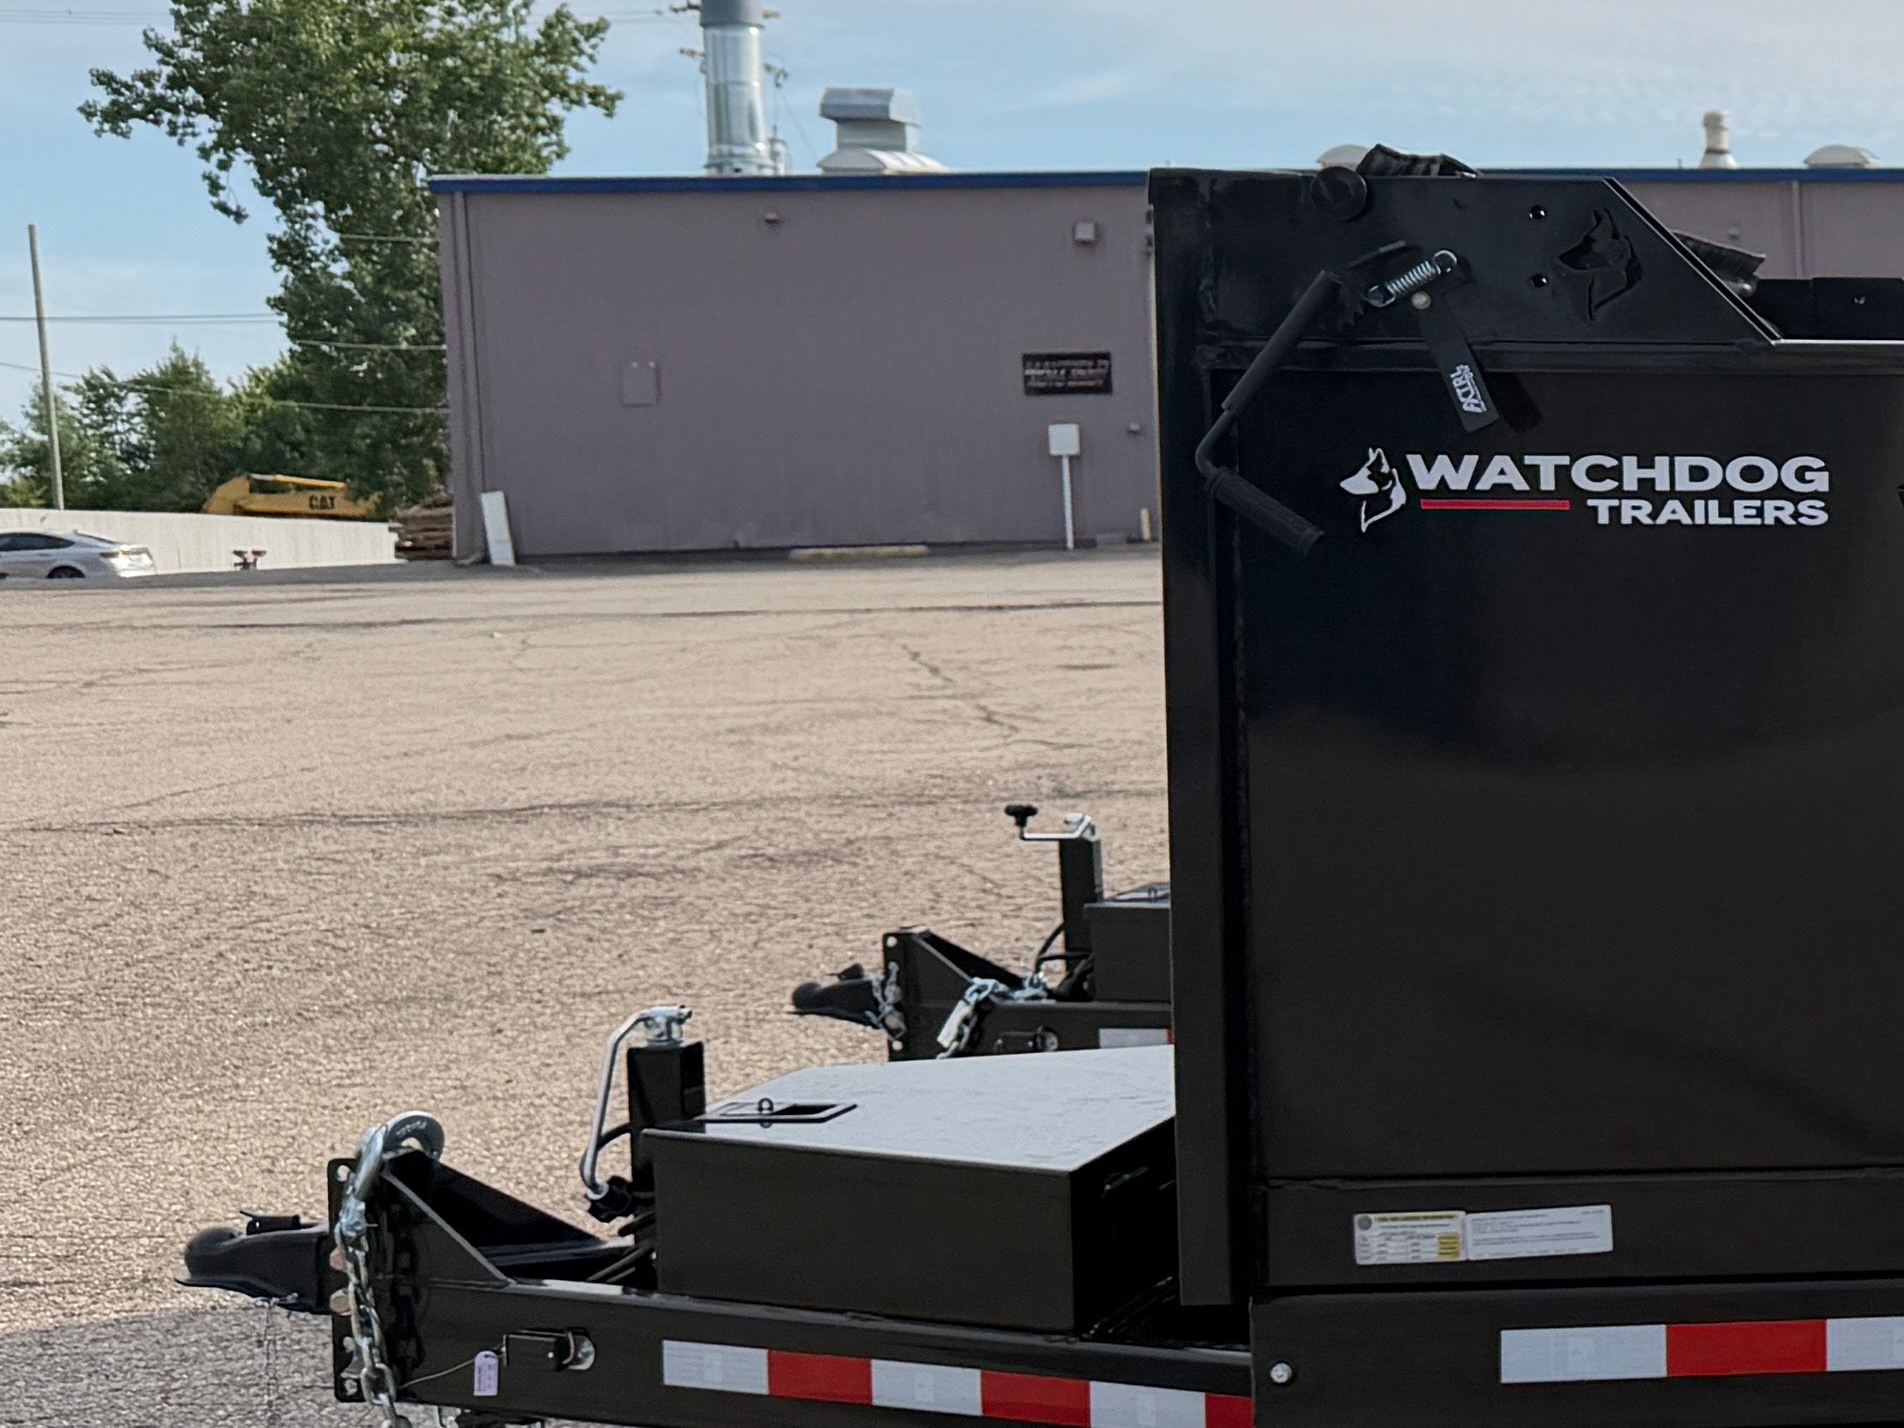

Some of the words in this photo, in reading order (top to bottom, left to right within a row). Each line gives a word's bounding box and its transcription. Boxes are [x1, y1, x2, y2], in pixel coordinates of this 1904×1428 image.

[1407, 454, 1830, 493] WATCHDOG
[309, 495, 335, 510] CAT
[1587, 499, 1829, 526] TRAILERS
